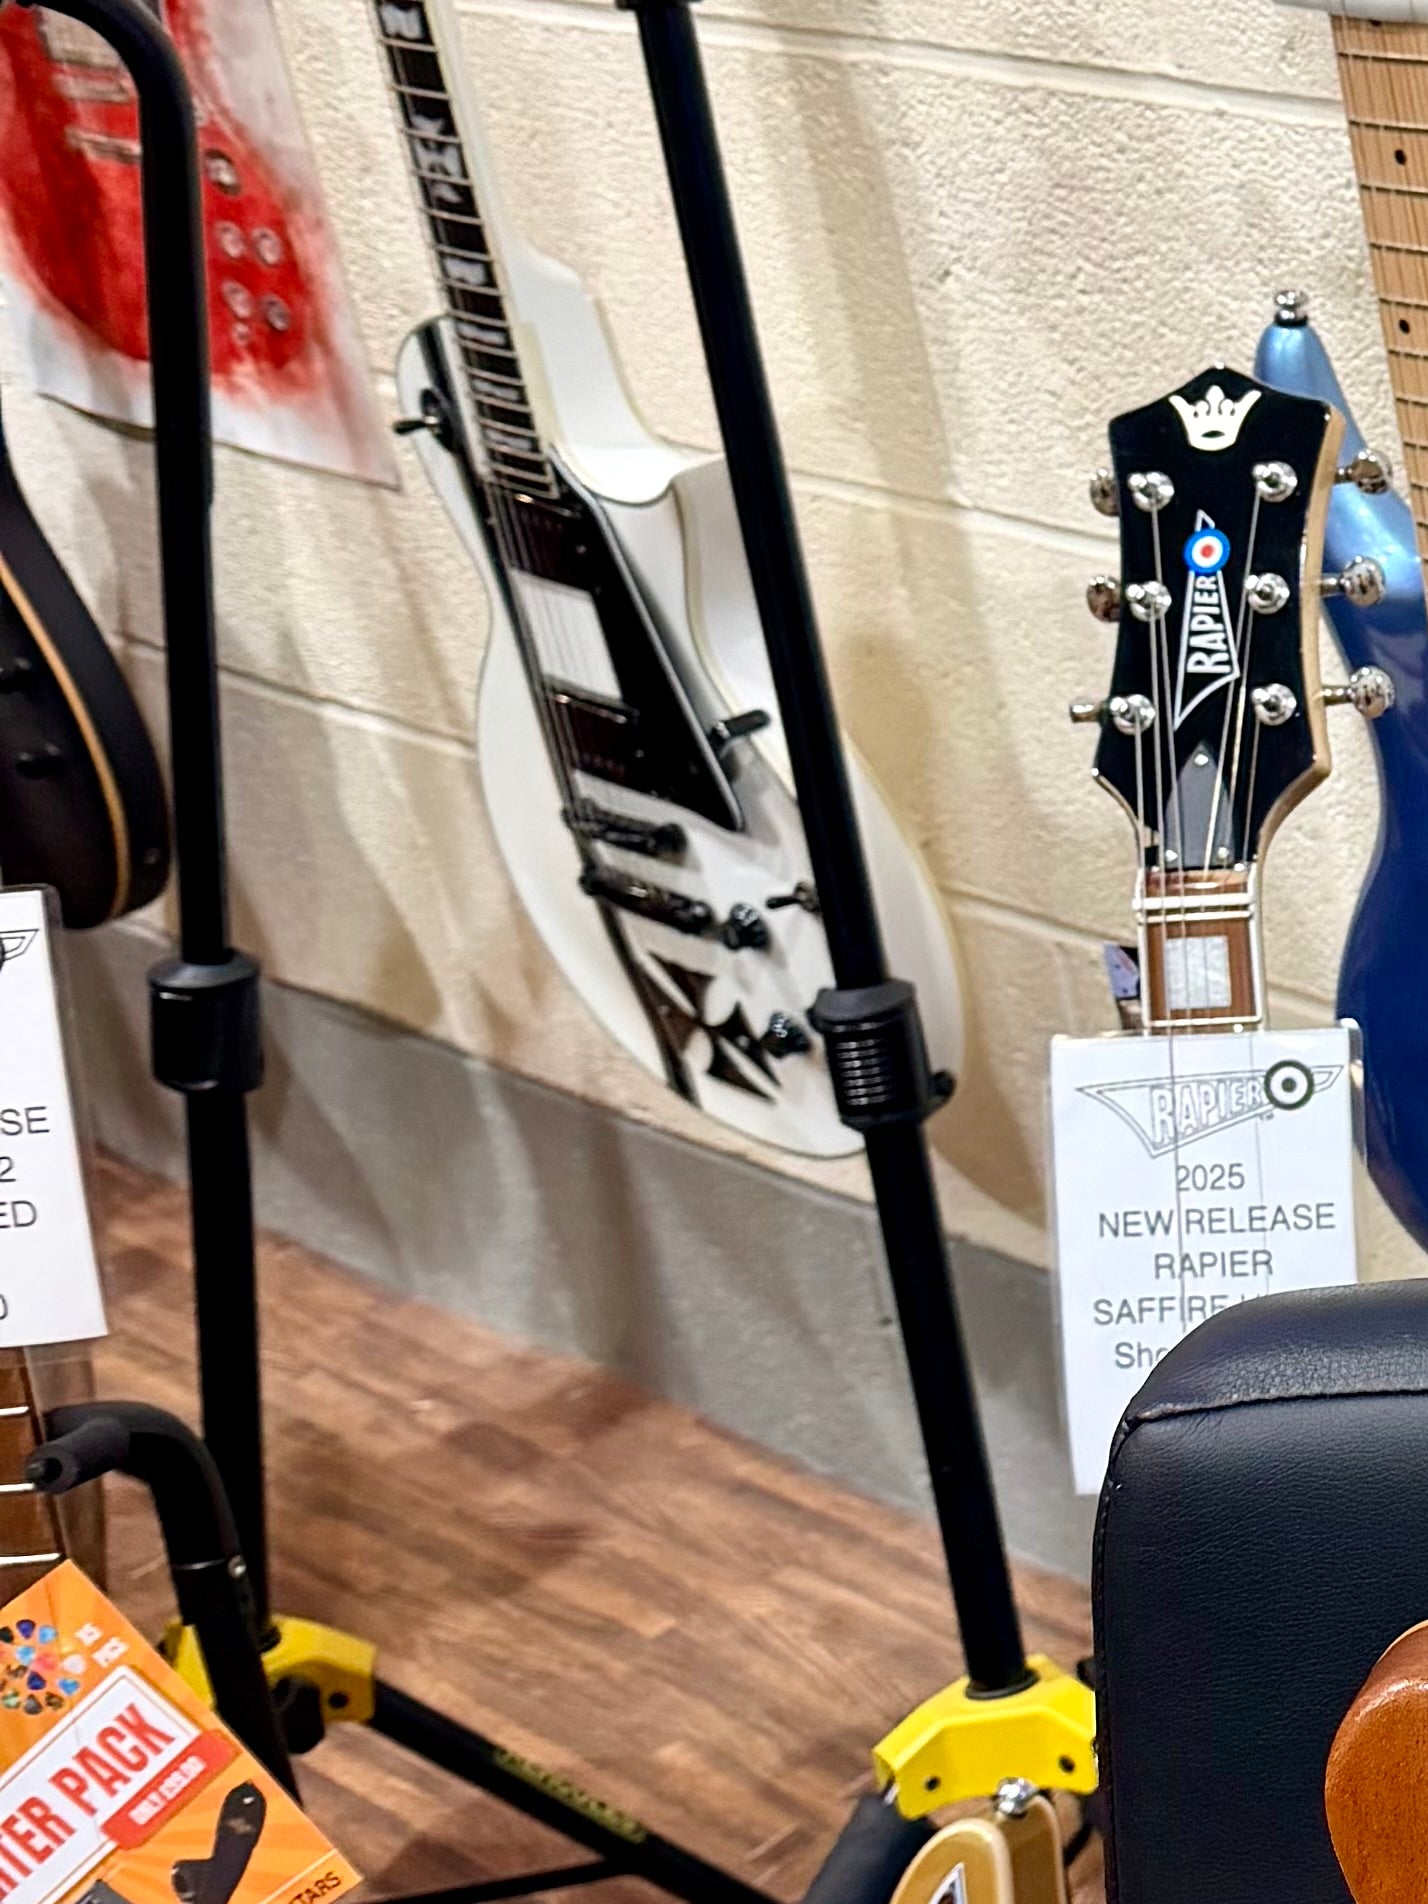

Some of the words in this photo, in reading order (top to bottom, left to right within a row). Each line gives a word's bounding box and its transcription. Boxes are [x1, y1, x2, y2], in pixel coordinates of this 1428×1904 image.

[1186, 575, 1232, 674] RAPIER
[1150, 1078, 1265, 1150] RAPIER
[1176, 1163, 1246, 1193] 2025
[1098, 1208, 1175, 1239] NEW
[1185, 1202, 1337, 1234] RELEASE
[1154, 1249, 1274, 1280] RAPIER
[48, 1702, 177, 1818] PACK
